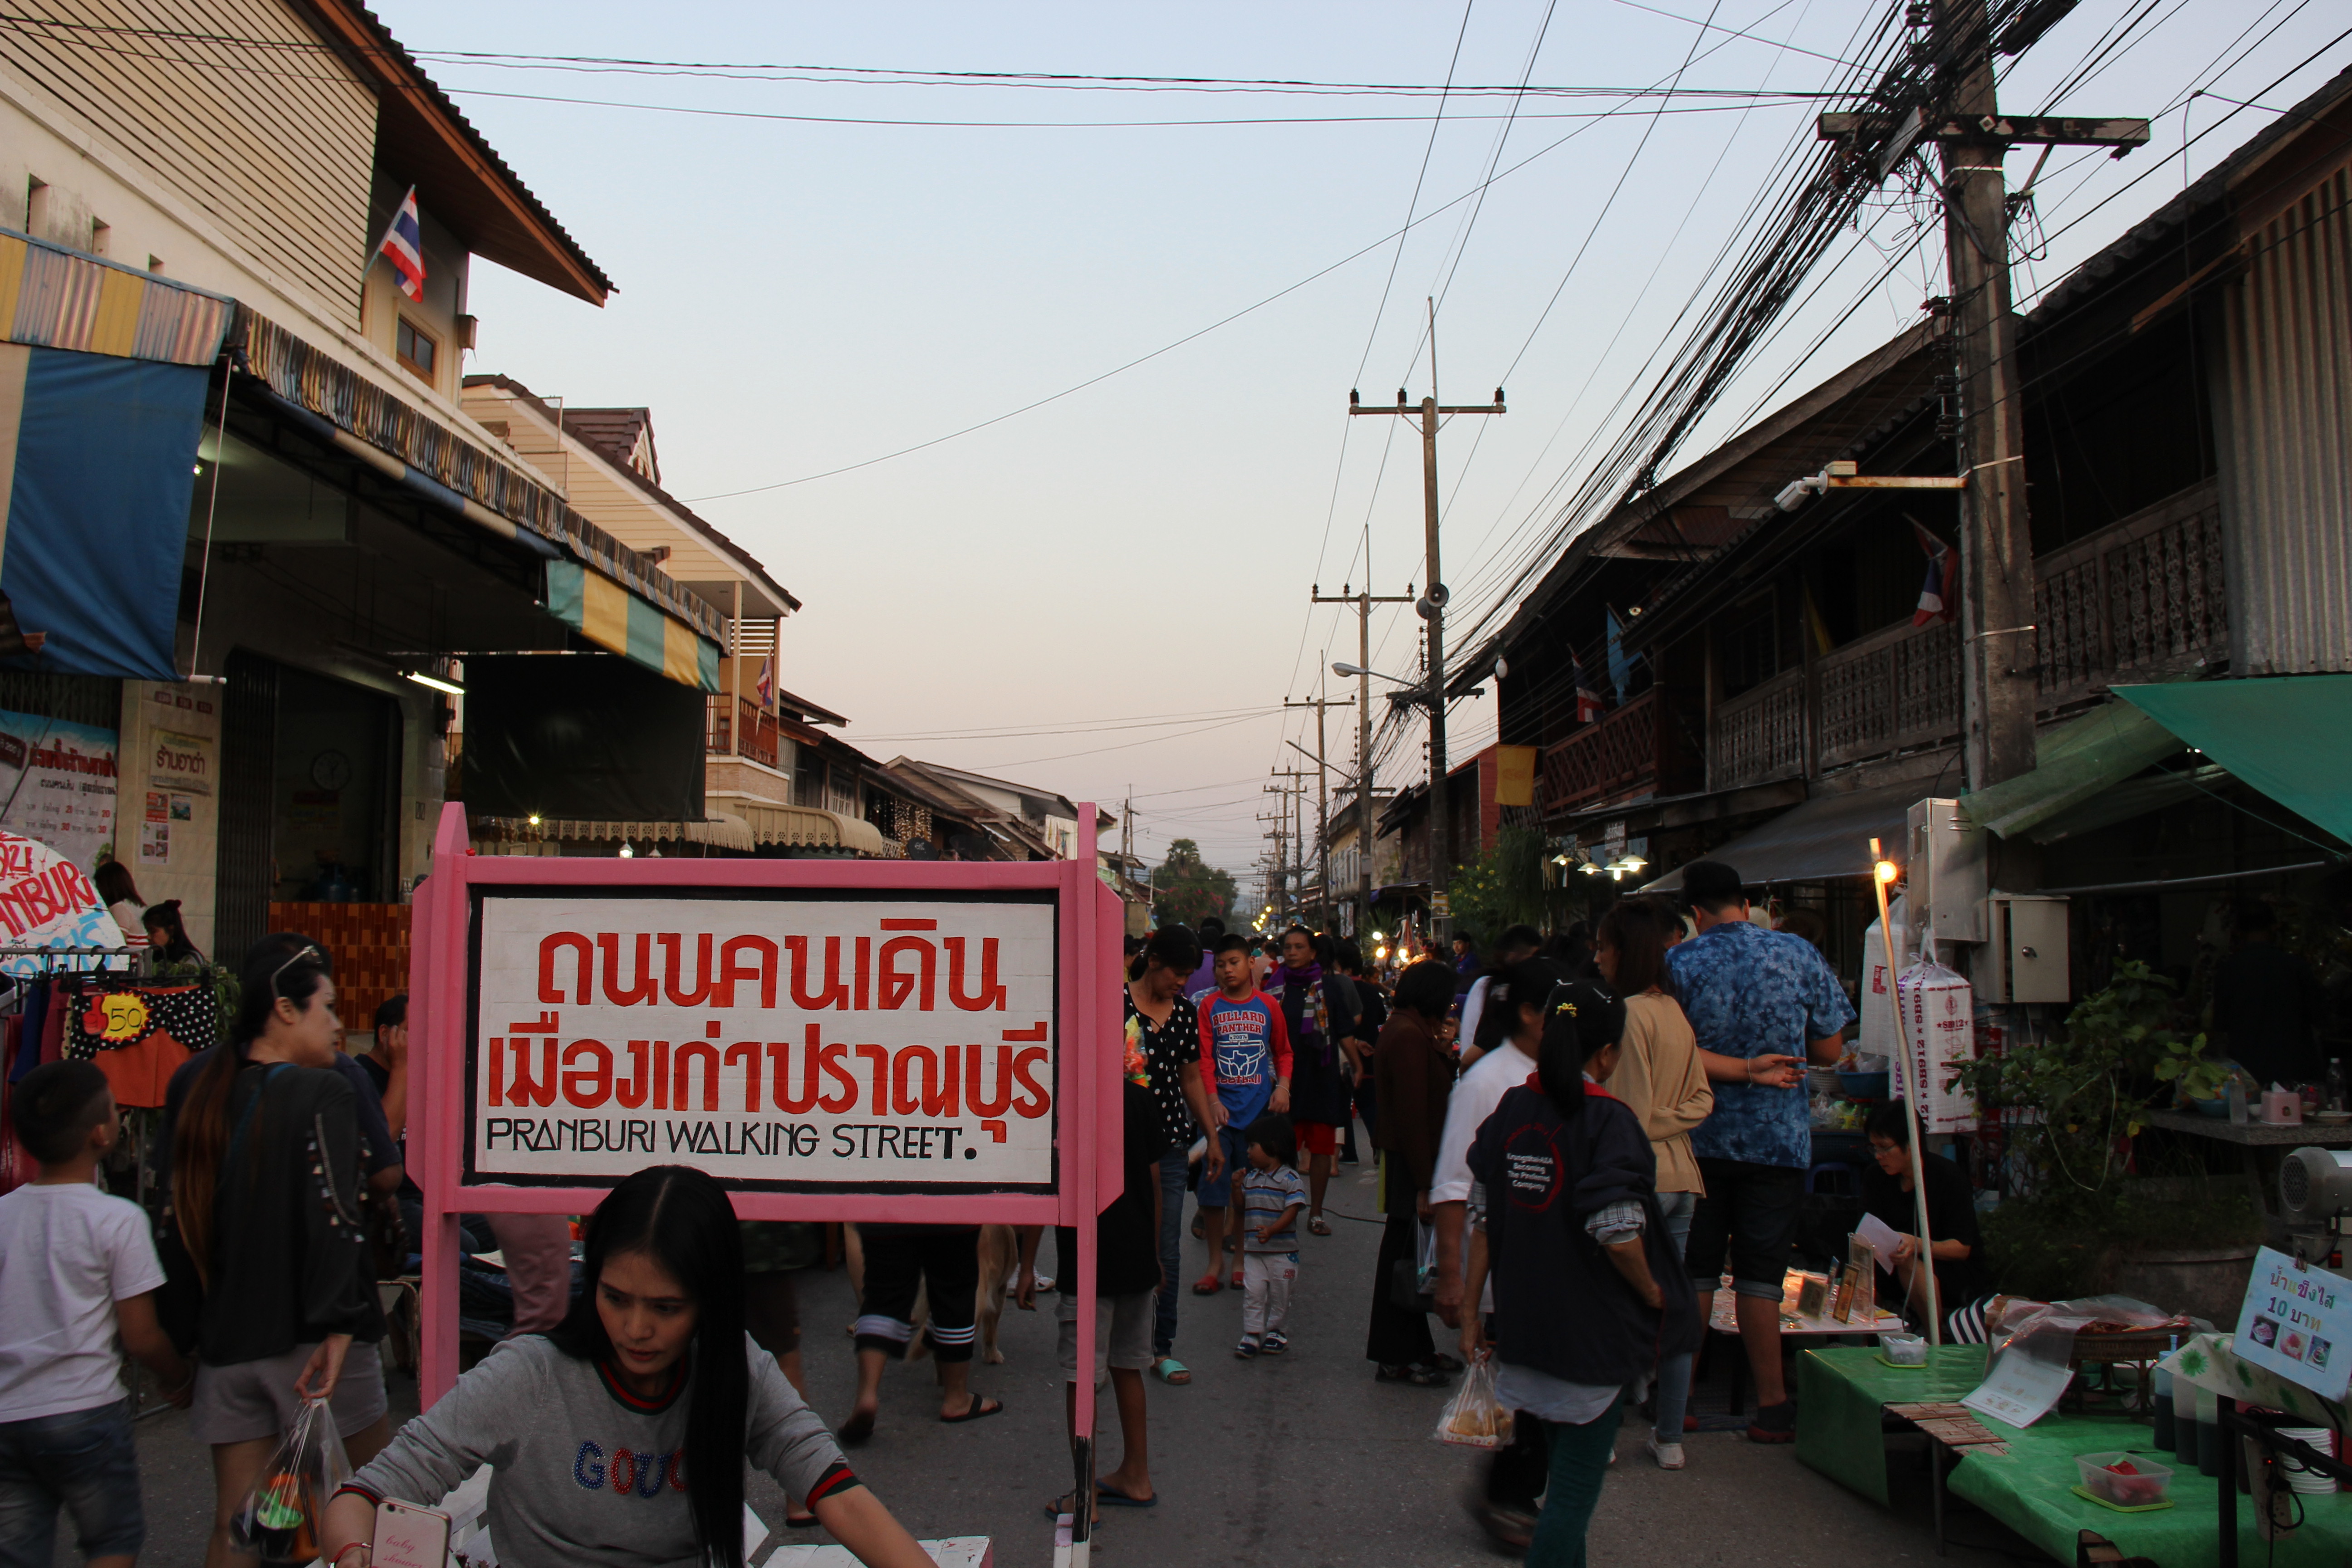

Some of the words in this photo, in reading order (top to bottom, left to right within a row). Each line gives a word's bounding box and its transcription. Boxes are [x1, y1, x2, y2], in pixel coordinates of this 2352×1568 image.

[61, 823, 70, 831] 30
[98, 825, 107, 833] 30
[538, 919, 1006, 1012] ถนนคนเดิน
[1212, 1010, 1266, 1028] BULLARD
[1217, 1023, 1263, 1036] PANTHER
[488, 1012, 1051, 1143] เมืองเก่าปราณบุรี
[1917, 1039, 1928, 1088] SB912
[487, 1117, 655, 1152] PRANBURI
[666, 1119, 820, 1156] WALKING
[833, 1124, 977, 1160] STREET.
[2268, 1296, 2288, 1317] 10
[2290, 1308, 2321, 1332] บาท
[386, 1535, 415, 1554] baby
